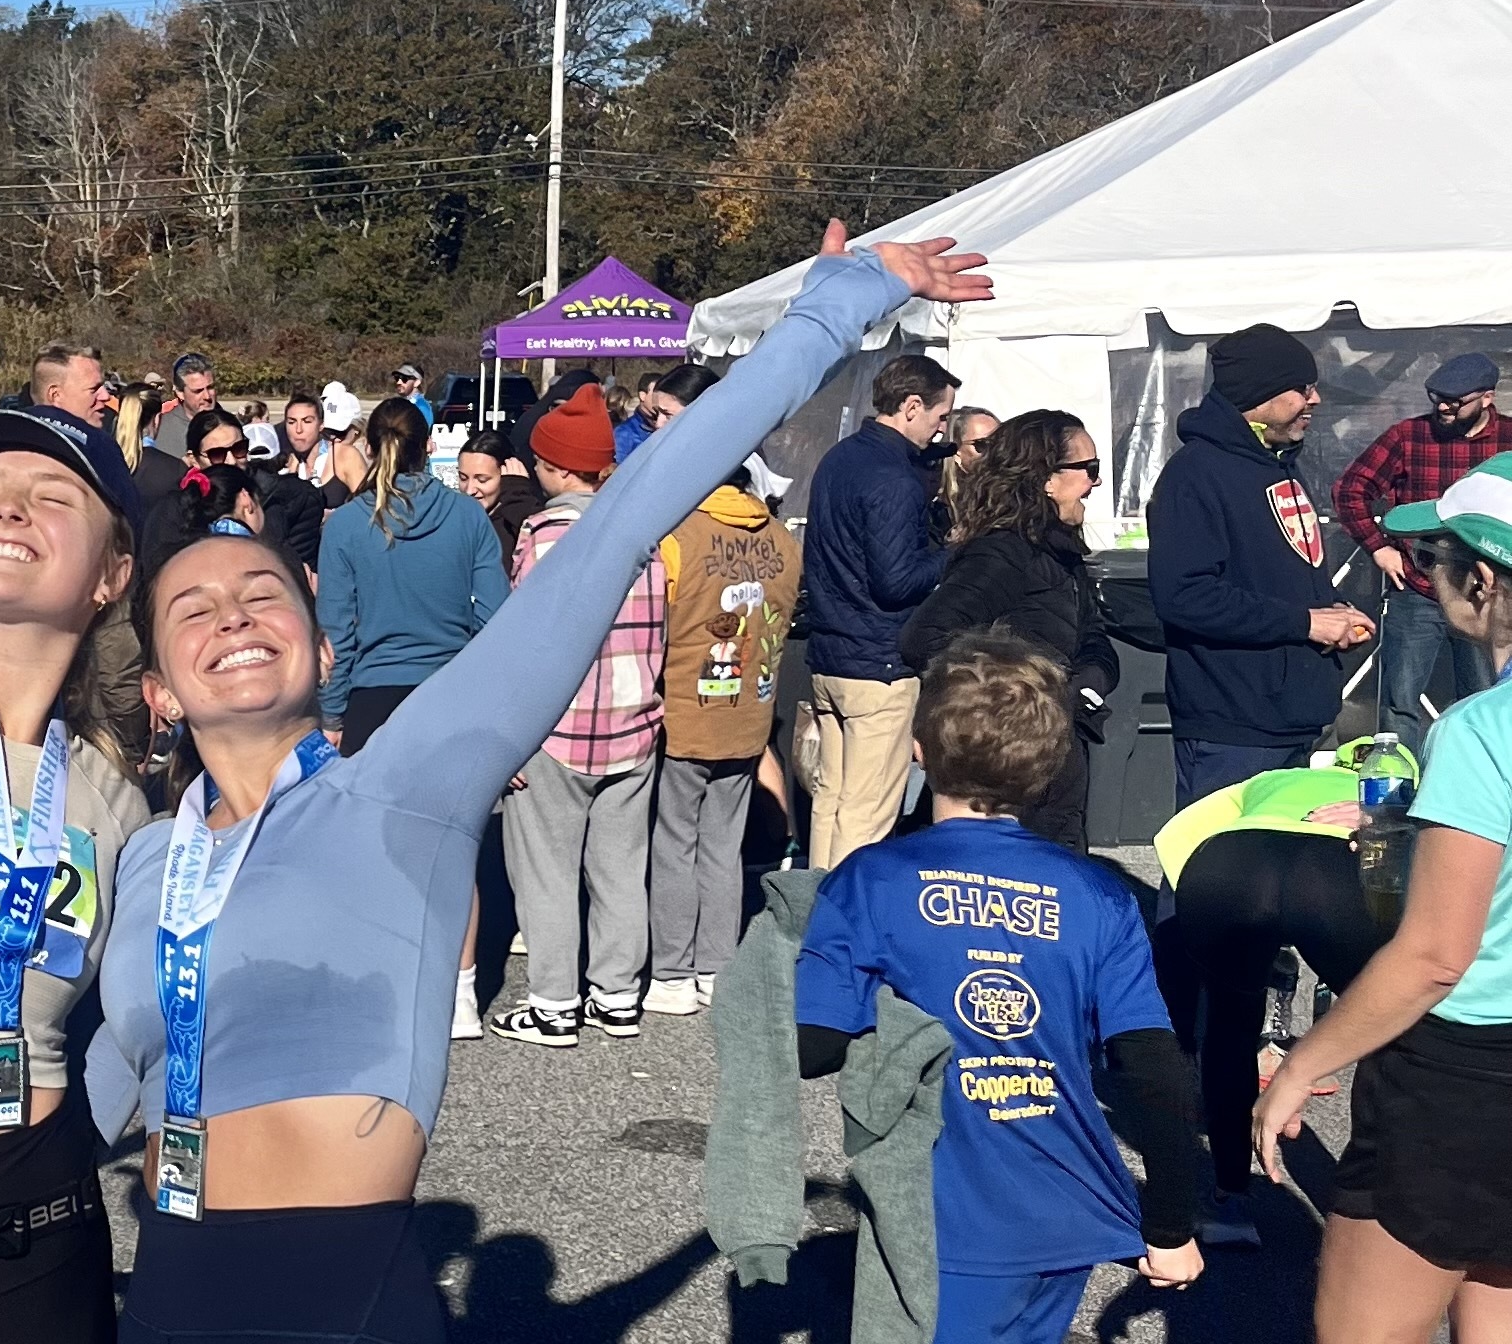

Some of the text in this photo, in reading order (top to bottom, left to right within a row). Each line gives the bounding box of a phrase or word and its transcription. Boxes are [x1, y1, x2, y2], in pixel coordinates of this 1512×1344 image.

[526, 338, 546, 349] Eat
[549, 337, 598, 351] Healthy,
[600, 338, 630, 348] Have
[31, 728, 62, 834] FINISHER
[9, 875, 39, 925] 13.1
[163, 843, 185, 922] Rhode Island
[918, 883, 1060, 941] CHASE
[177, 944, 201, 1001] 13.1
